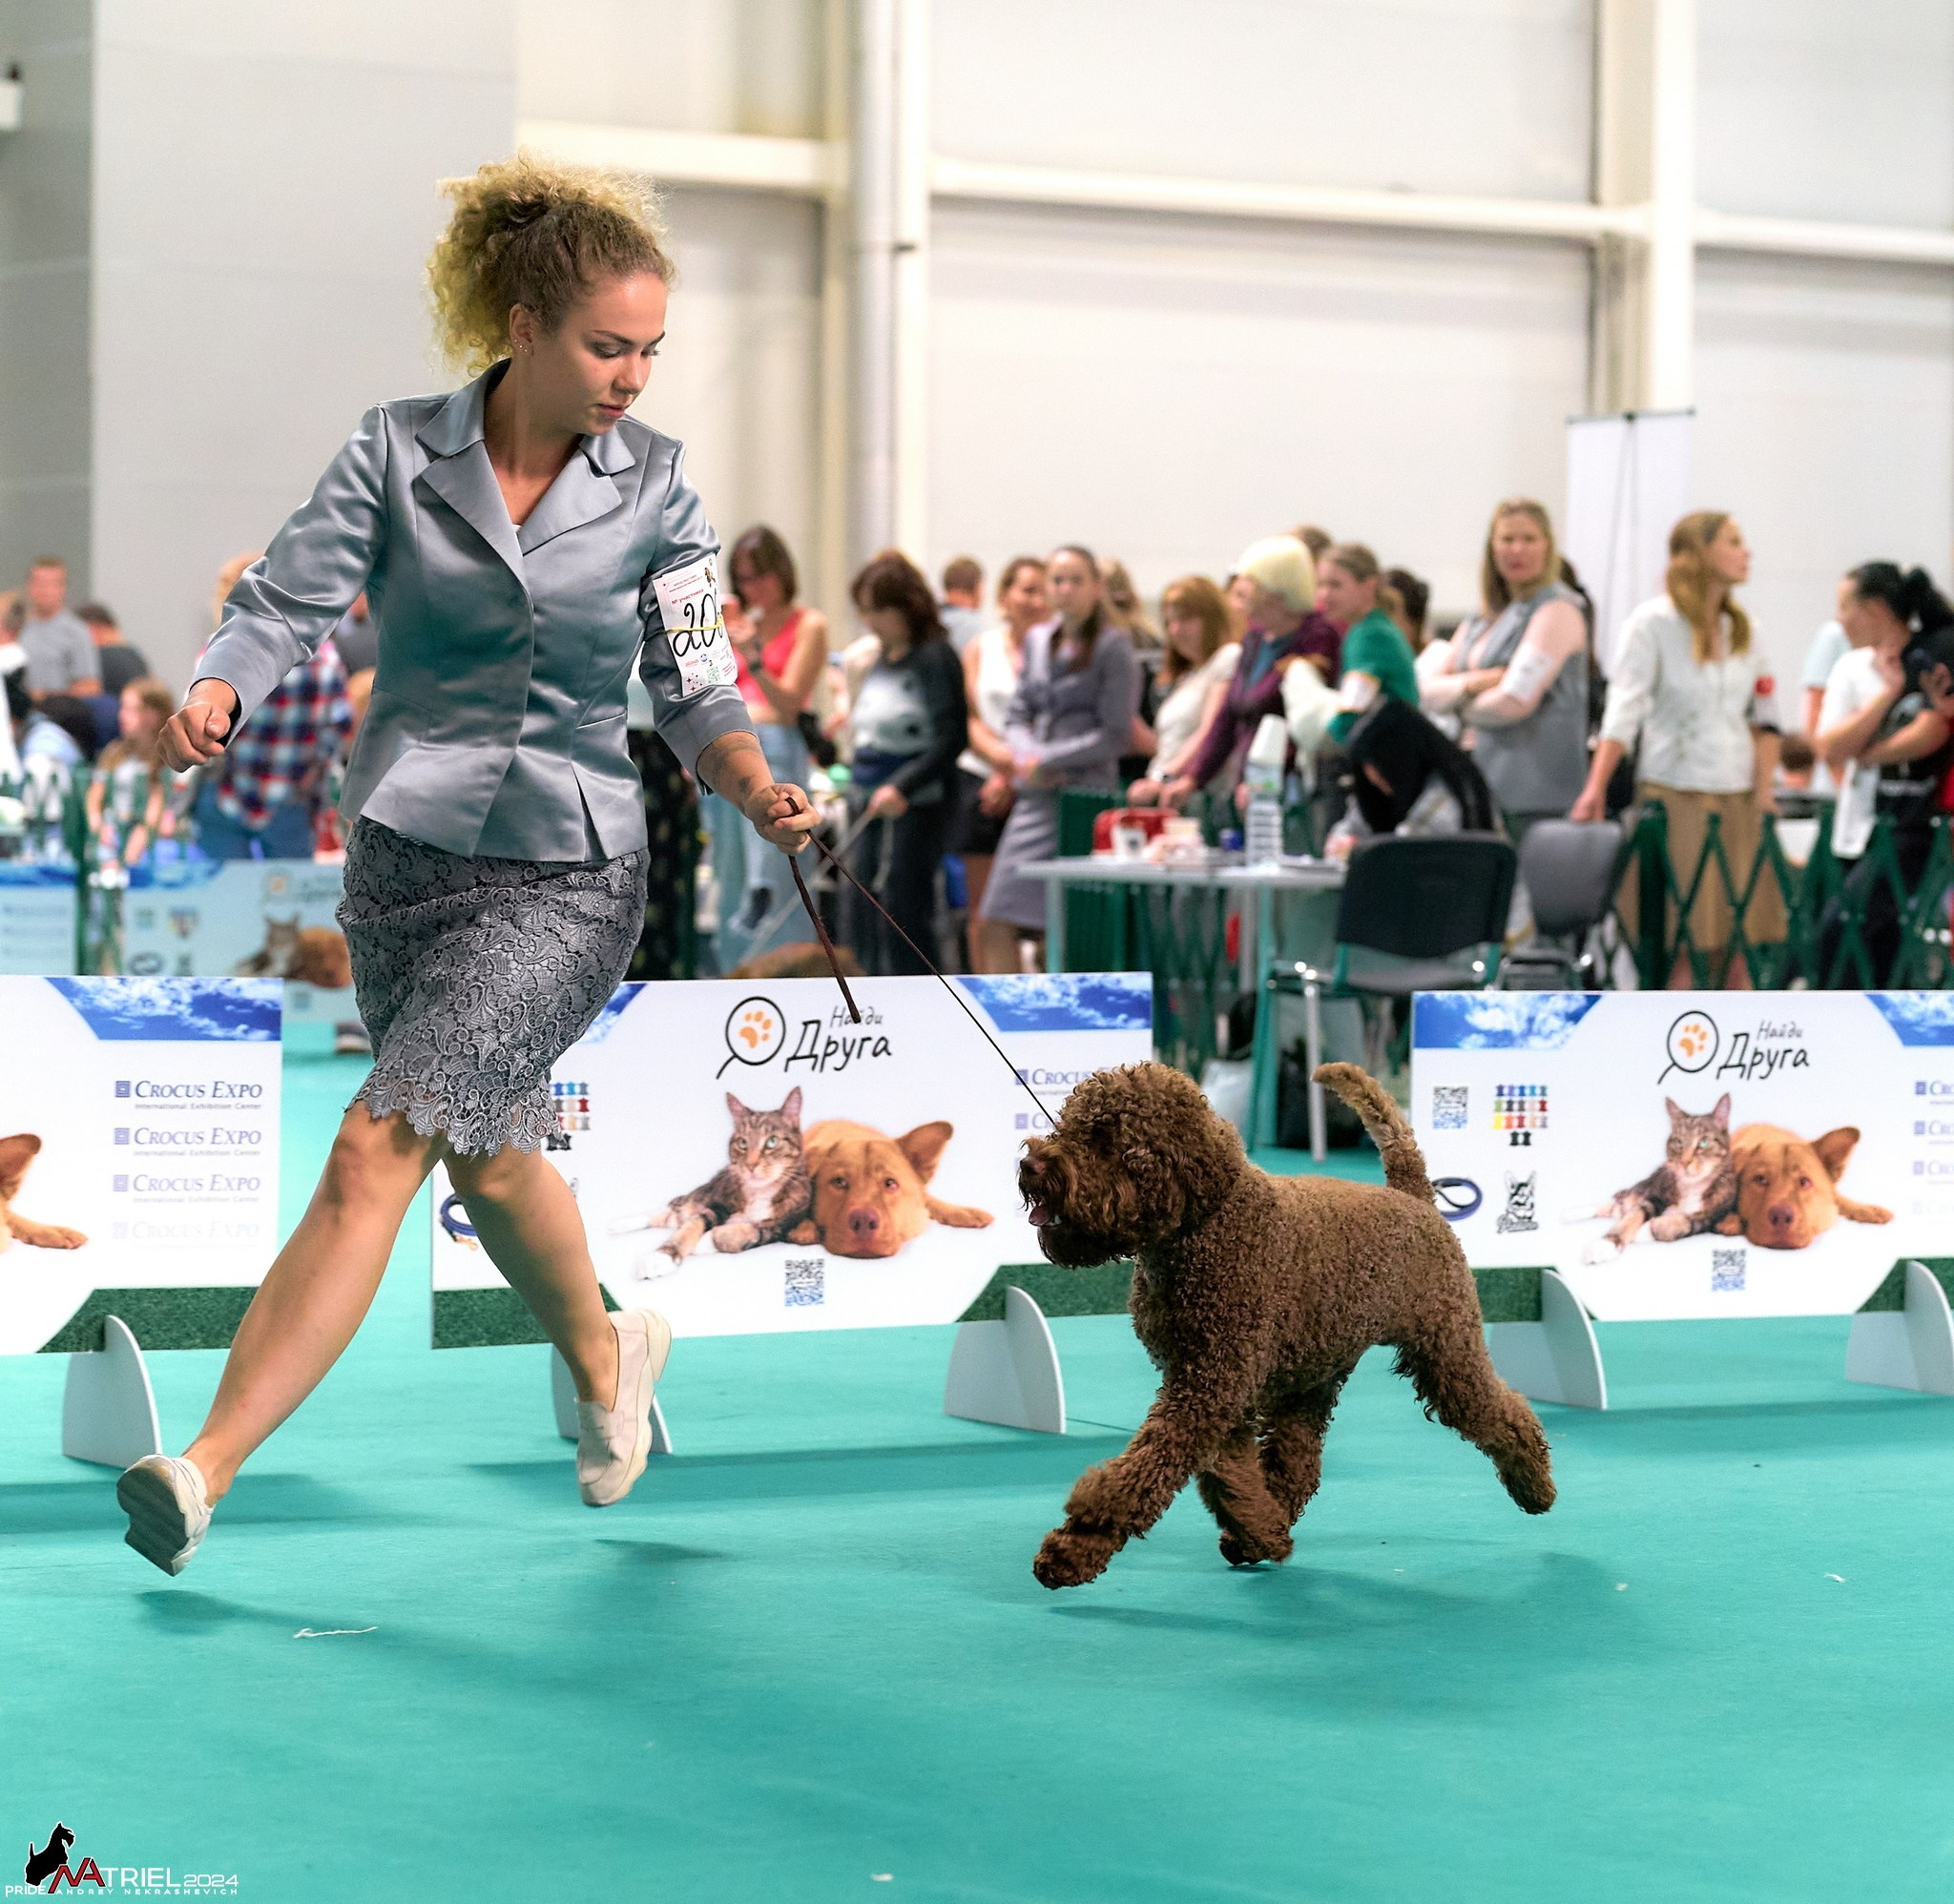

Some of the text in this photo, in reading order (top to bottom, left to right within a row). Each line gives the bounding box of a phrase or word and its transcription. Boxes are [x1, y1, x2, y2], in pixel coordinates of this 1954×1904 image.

[829, 1005, 883, 1028] Нади
[1757, 1020, 1803, 1041] Найди
[783, 1019, 893, 1073] Друга
[1715, 1032, 1810, 1081] Друга
[135, 1080, 262, 1098] CROCUS EXPO
[135, 1127, 261, 1145] CROCUS EXPO
[133, 1174, 260, 1191] CROCUS EXPO
